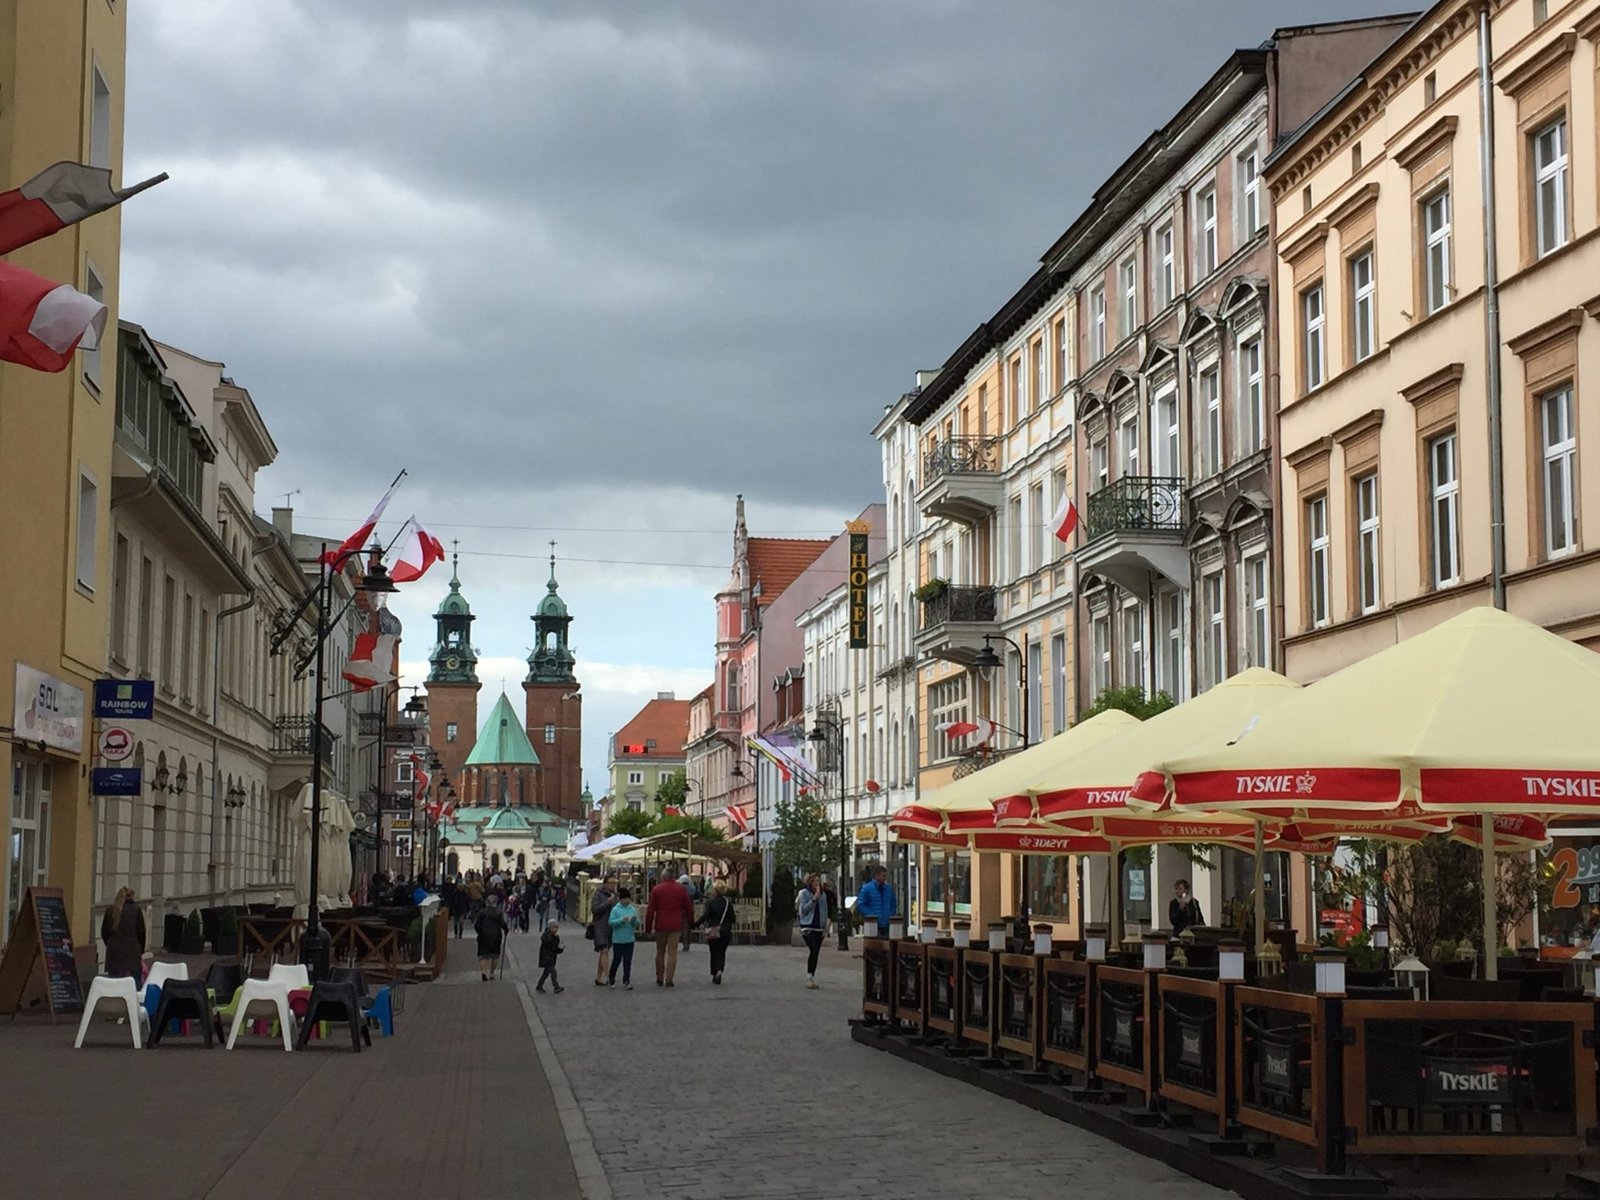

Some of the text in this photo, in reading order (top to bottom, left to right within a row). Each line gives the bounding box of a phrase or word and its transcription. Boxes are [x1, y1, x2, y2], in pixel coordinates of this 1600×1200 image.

[851, 553, 867, 640] HOTEL
[101, 700, 147, 709] RAINBOW
[1235, 775, 1294, 793] TYSKIE
[1439, 1071, 1499, 1090] TYSKIE
